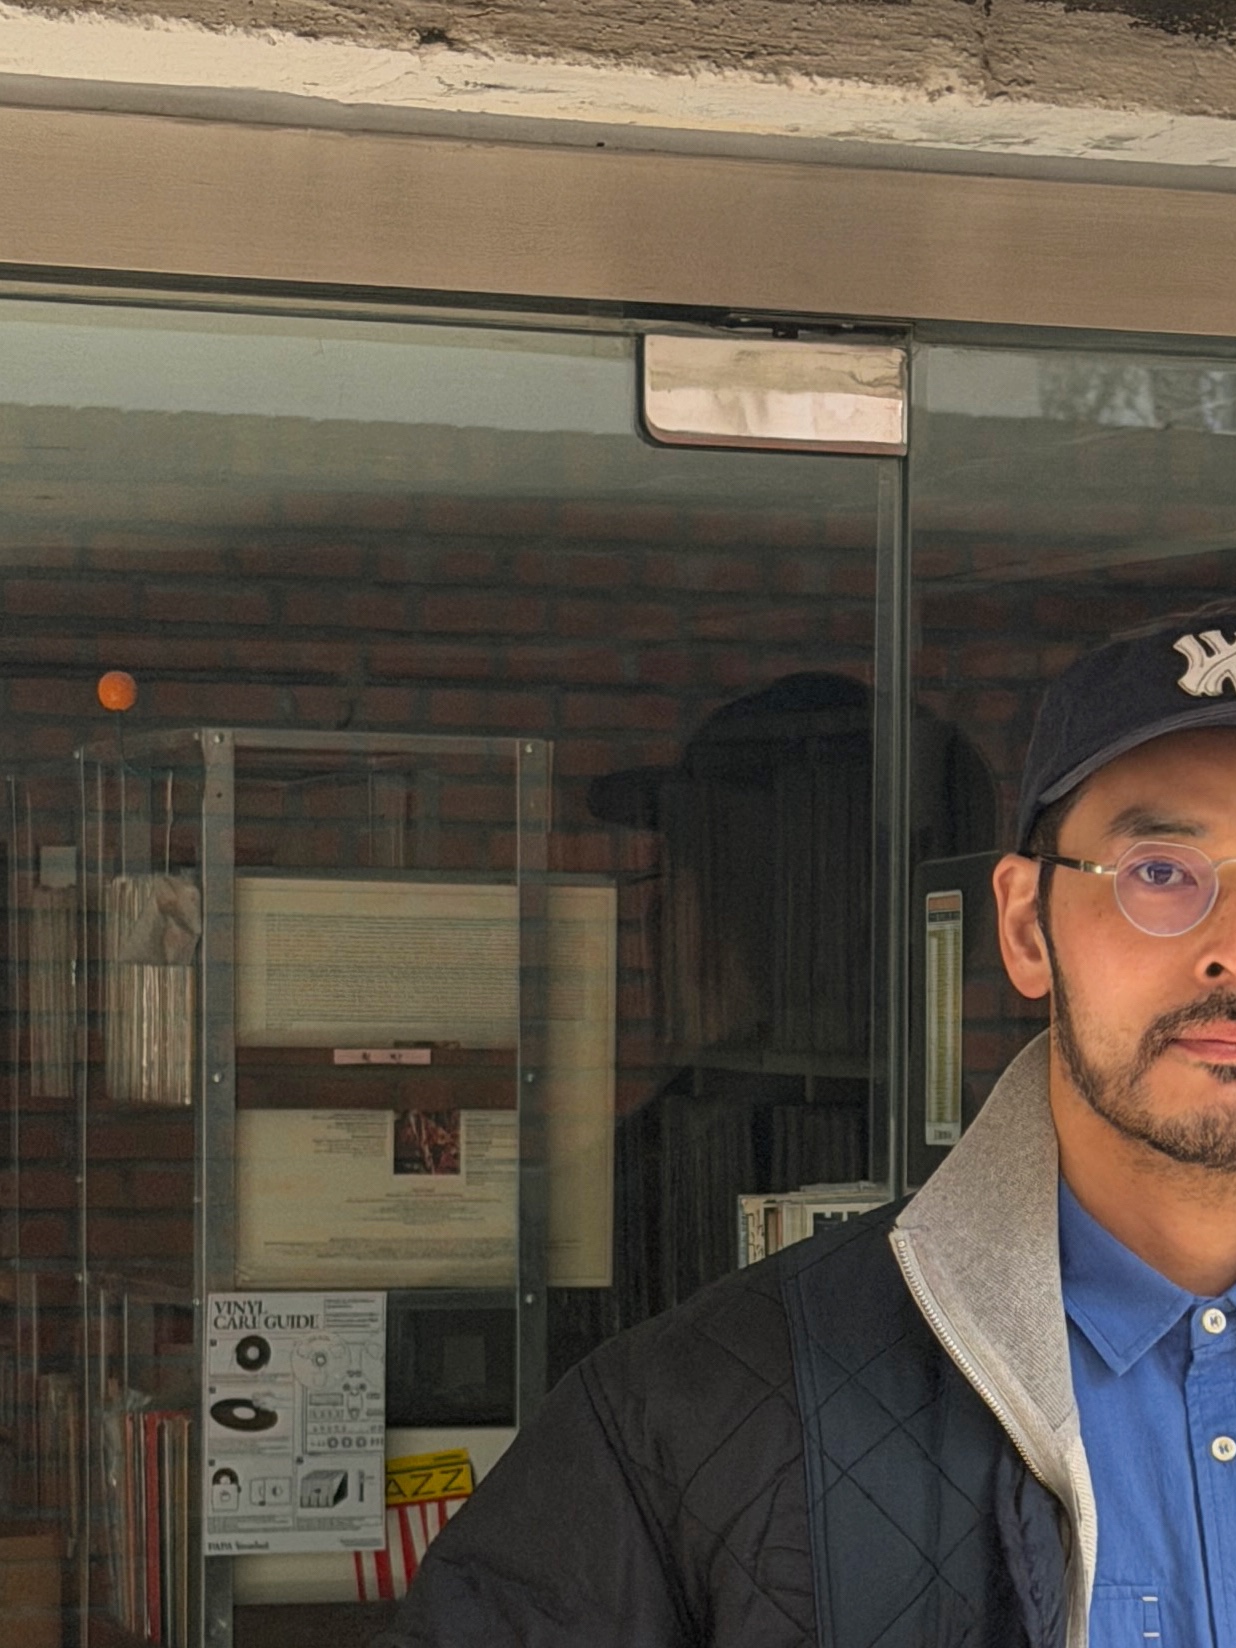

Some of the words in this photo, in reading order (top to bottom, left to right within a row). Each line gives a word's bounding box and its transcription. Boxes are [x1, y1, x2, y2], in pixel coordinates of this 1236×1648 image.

[214, 1301, 267, 1315] VINYL
[213, 1314, 258, 1330] CARE
[263, 1314, 320, 1330] GUIDE
